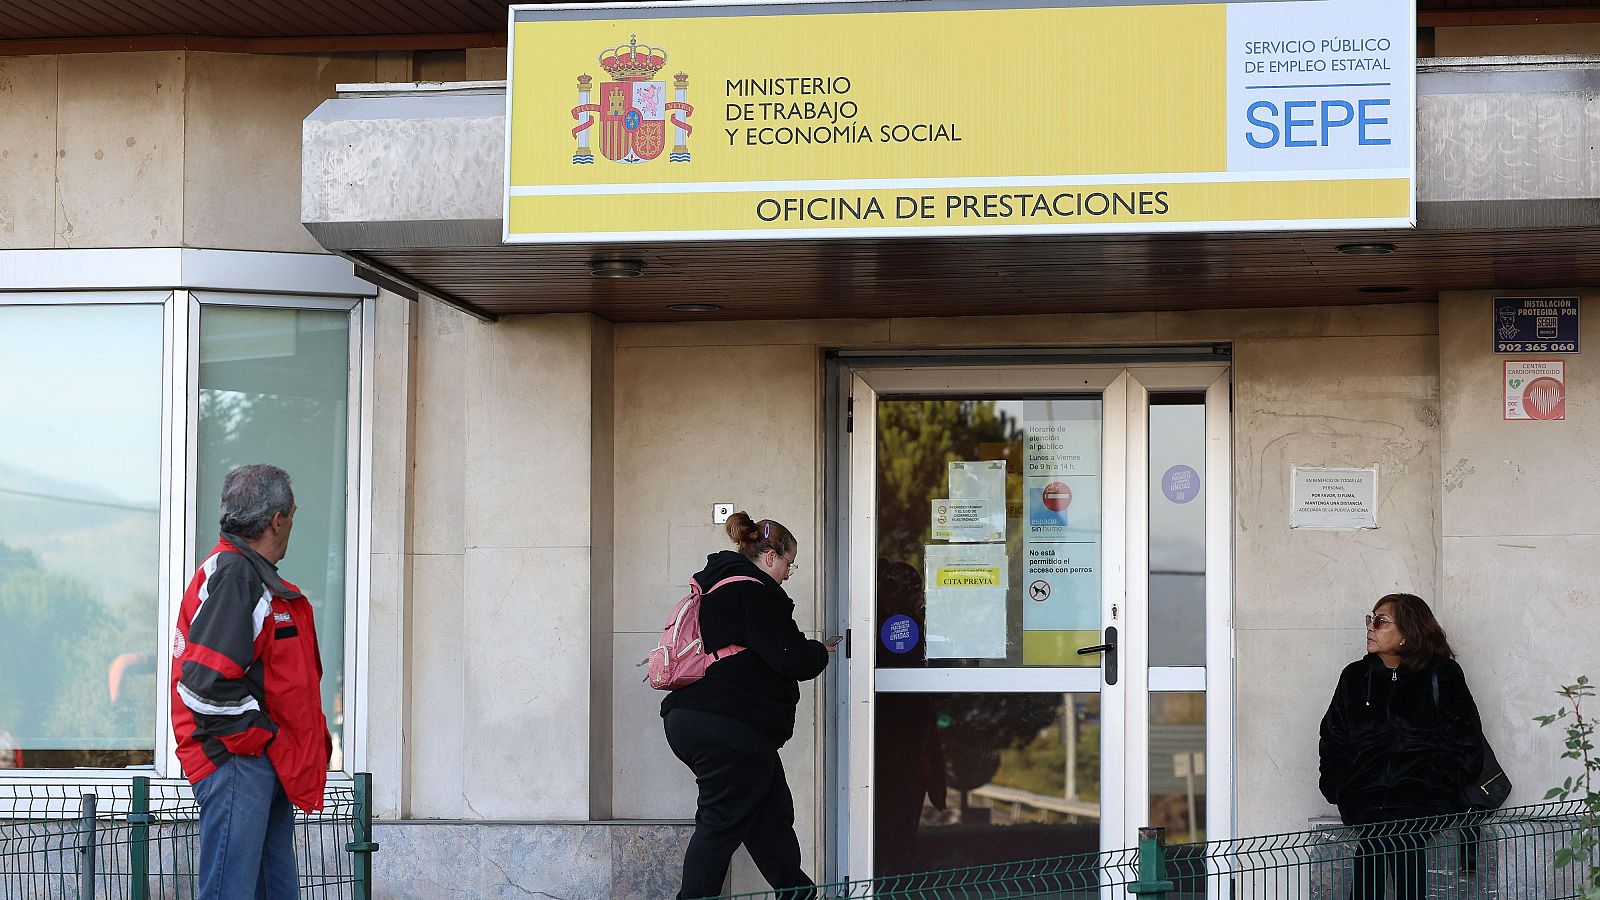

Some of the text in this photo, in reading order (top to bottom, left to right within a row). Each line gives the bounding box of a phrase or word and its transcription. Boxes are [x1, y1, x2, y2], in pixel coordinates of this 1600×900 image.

[1245, 36, 1391, 55] SERVICIO PÚBLICO
[1245, 58, 1391, 74] DE EMPLEO ESTATAL
[726, 76, 851, 97] MINISTERIO
[726, 101, 858, 123] DE TRABAJO
[1245, 98, 1392, 149] SEPE
[725, 121, 962, 146] Y ECONOMÍA SOCIAL
[756, 191, 1169, 222] OFICINA DE PRESTACIONES
[1524, 300, 1571, 308] INSTALACIÓN
[1518, 308, 1577, 316] PROTEGIDA POR
[1537, 317, 1557, 327] SEGUR
[1498, 343, 1575, 352] 902 365 060
[1029, 425, 1066, 433] Horario de
[1029, 434, 1060, 442] atención
[1037, 443, 1064, 452] público
[1031, 517, 1057, 526] espacio
[1029, 558, 1062, 566] permitido
[1069, 567, 1093, 575] perros
